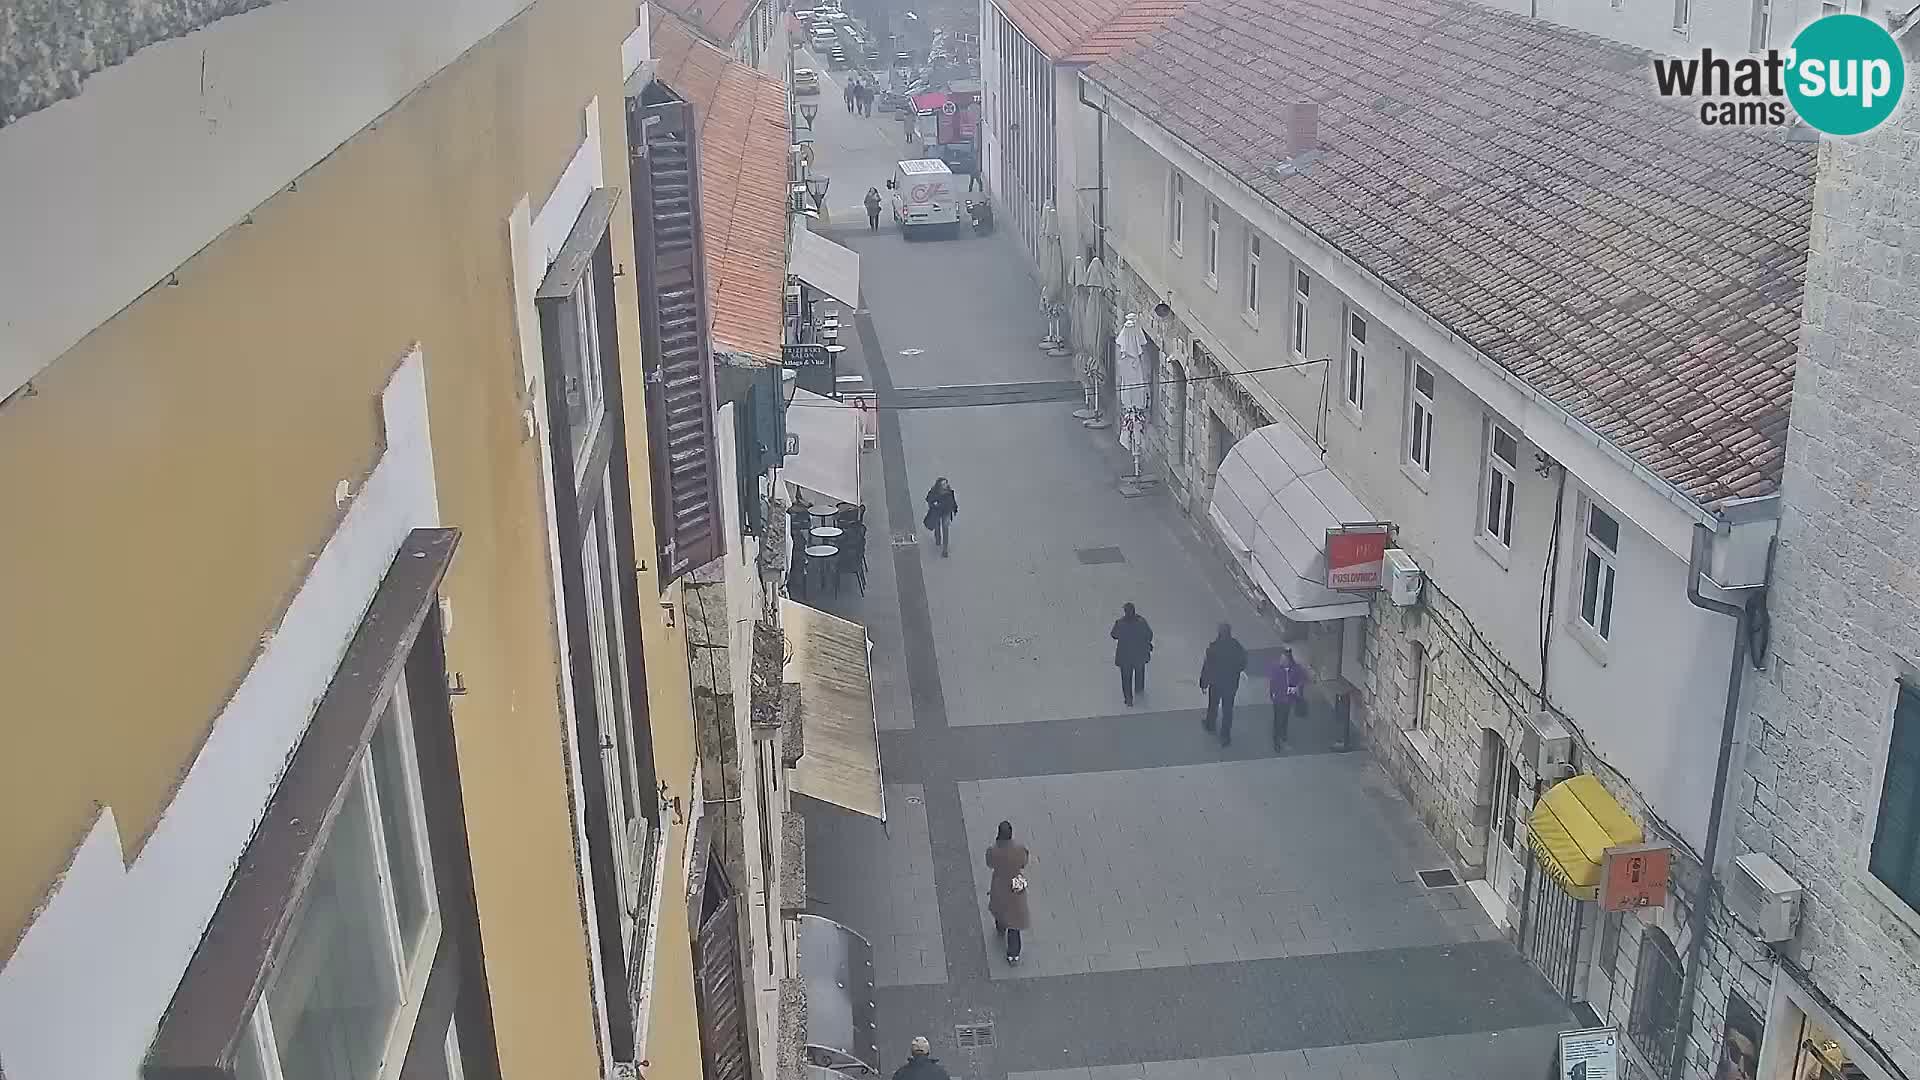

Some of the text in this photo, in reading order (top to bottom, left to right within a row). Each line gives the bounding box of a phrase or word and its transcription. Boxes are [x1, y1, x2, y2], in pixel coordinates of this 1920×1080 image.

[1332, 571, 1377, 584] POSLOVNICA
[1528, 832, 1568, 890] STUDIO IVAN
